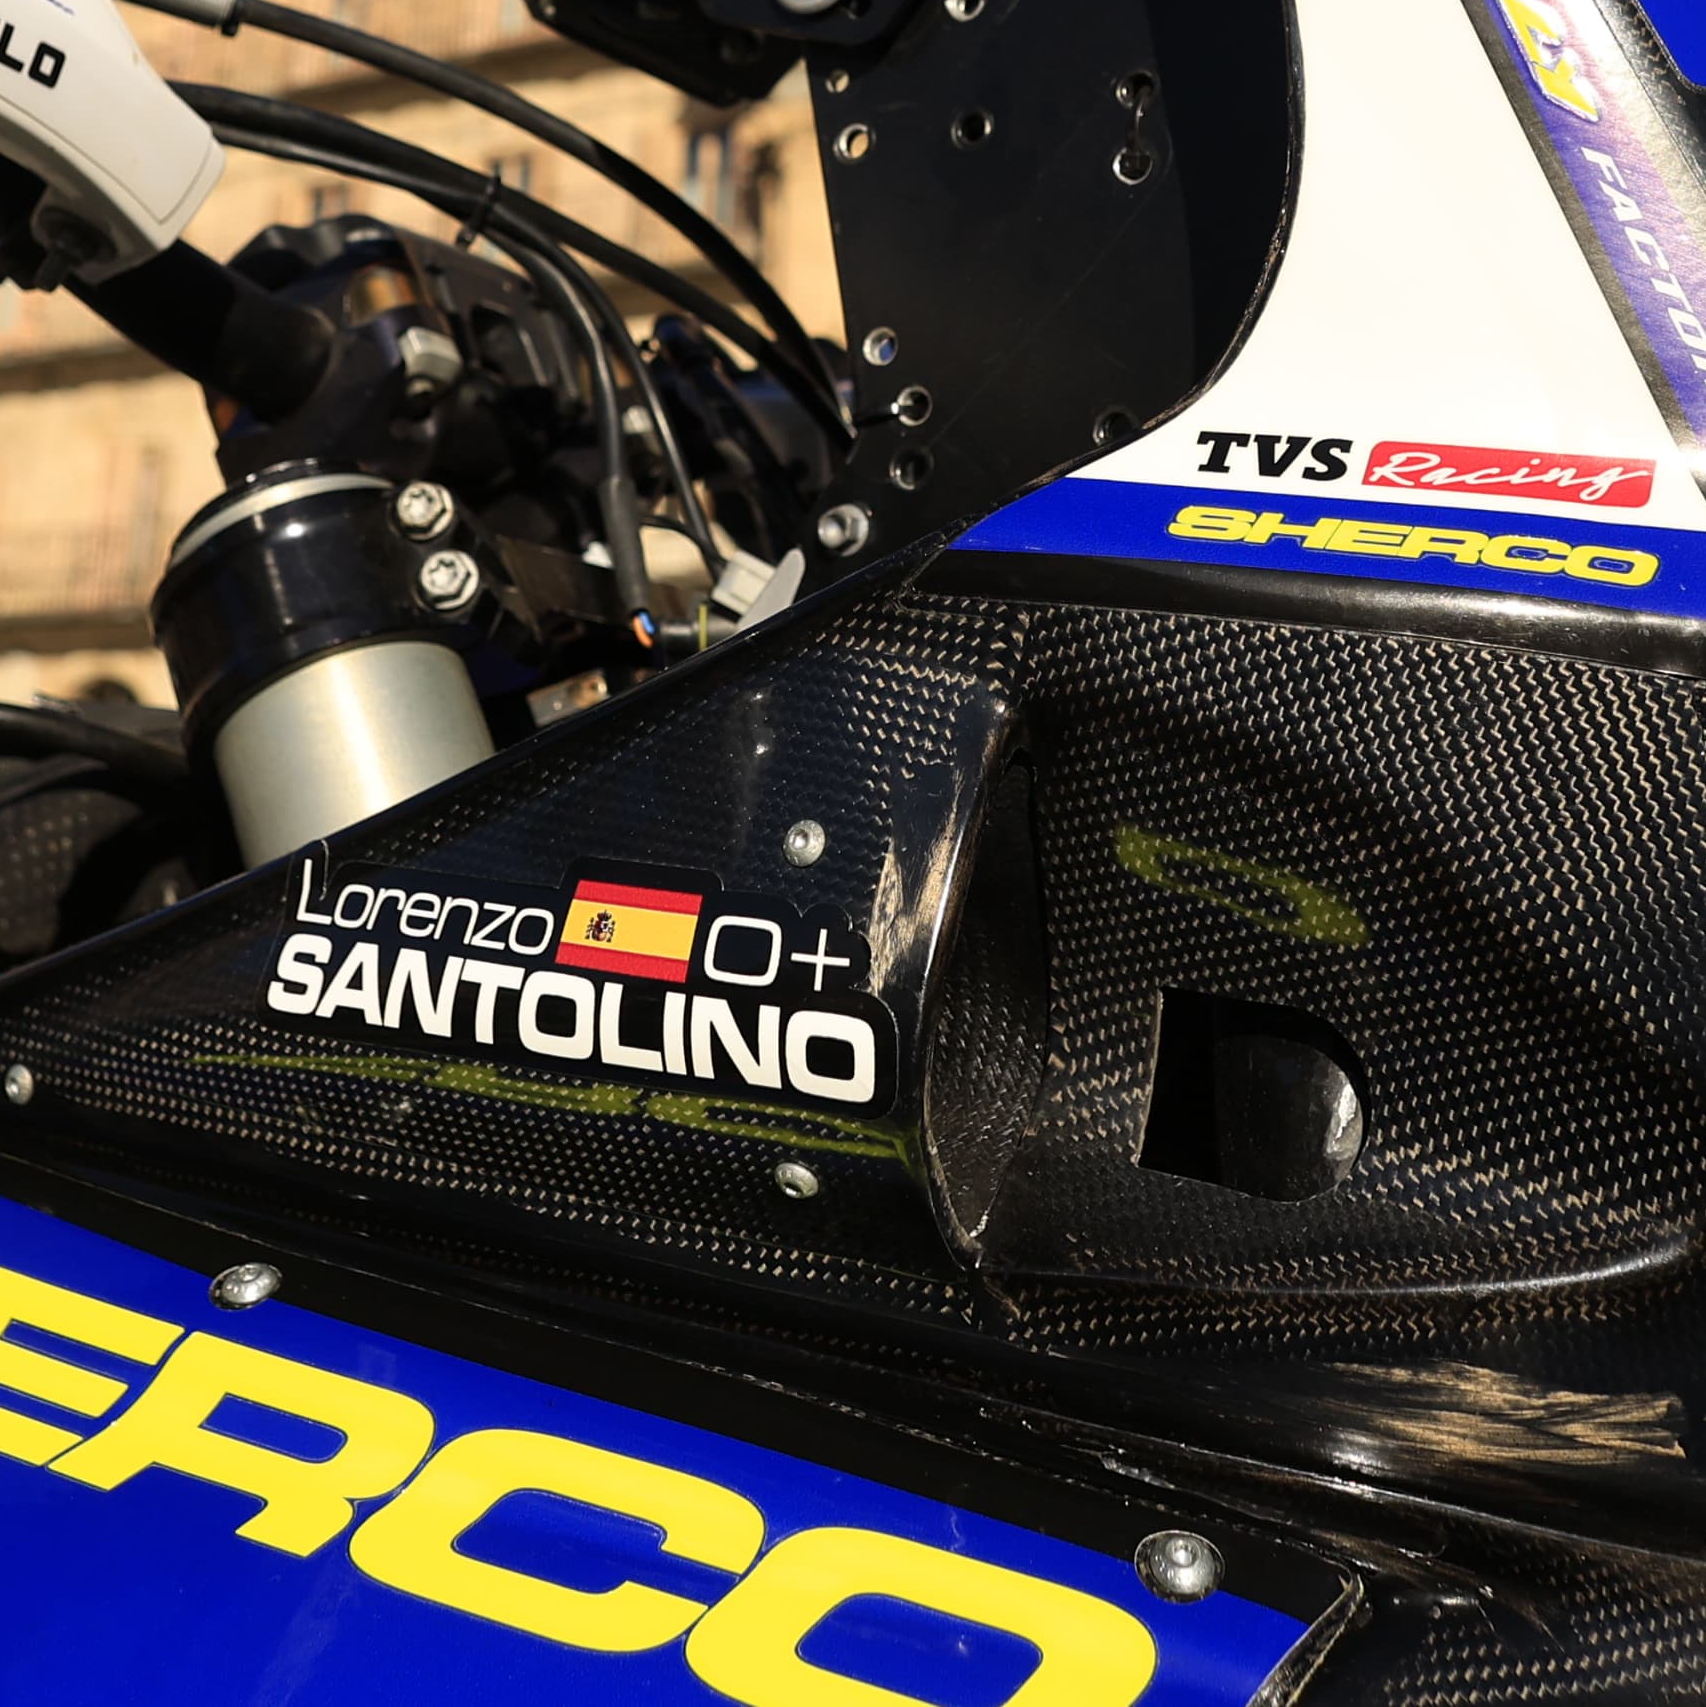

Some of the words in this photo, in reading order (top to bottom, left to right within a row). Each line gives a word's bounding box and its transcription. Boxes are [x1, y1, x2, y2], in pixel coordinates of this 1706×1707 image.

[1197, 431, 1353, 482] TVS
[1368, 450, 1650, 501] Racing
[1167, 505, 1660, 587] SHERCO
[296, 858, 555, 955] Lorenzo
[266, 933, 876, 1104] SANTOLINO
